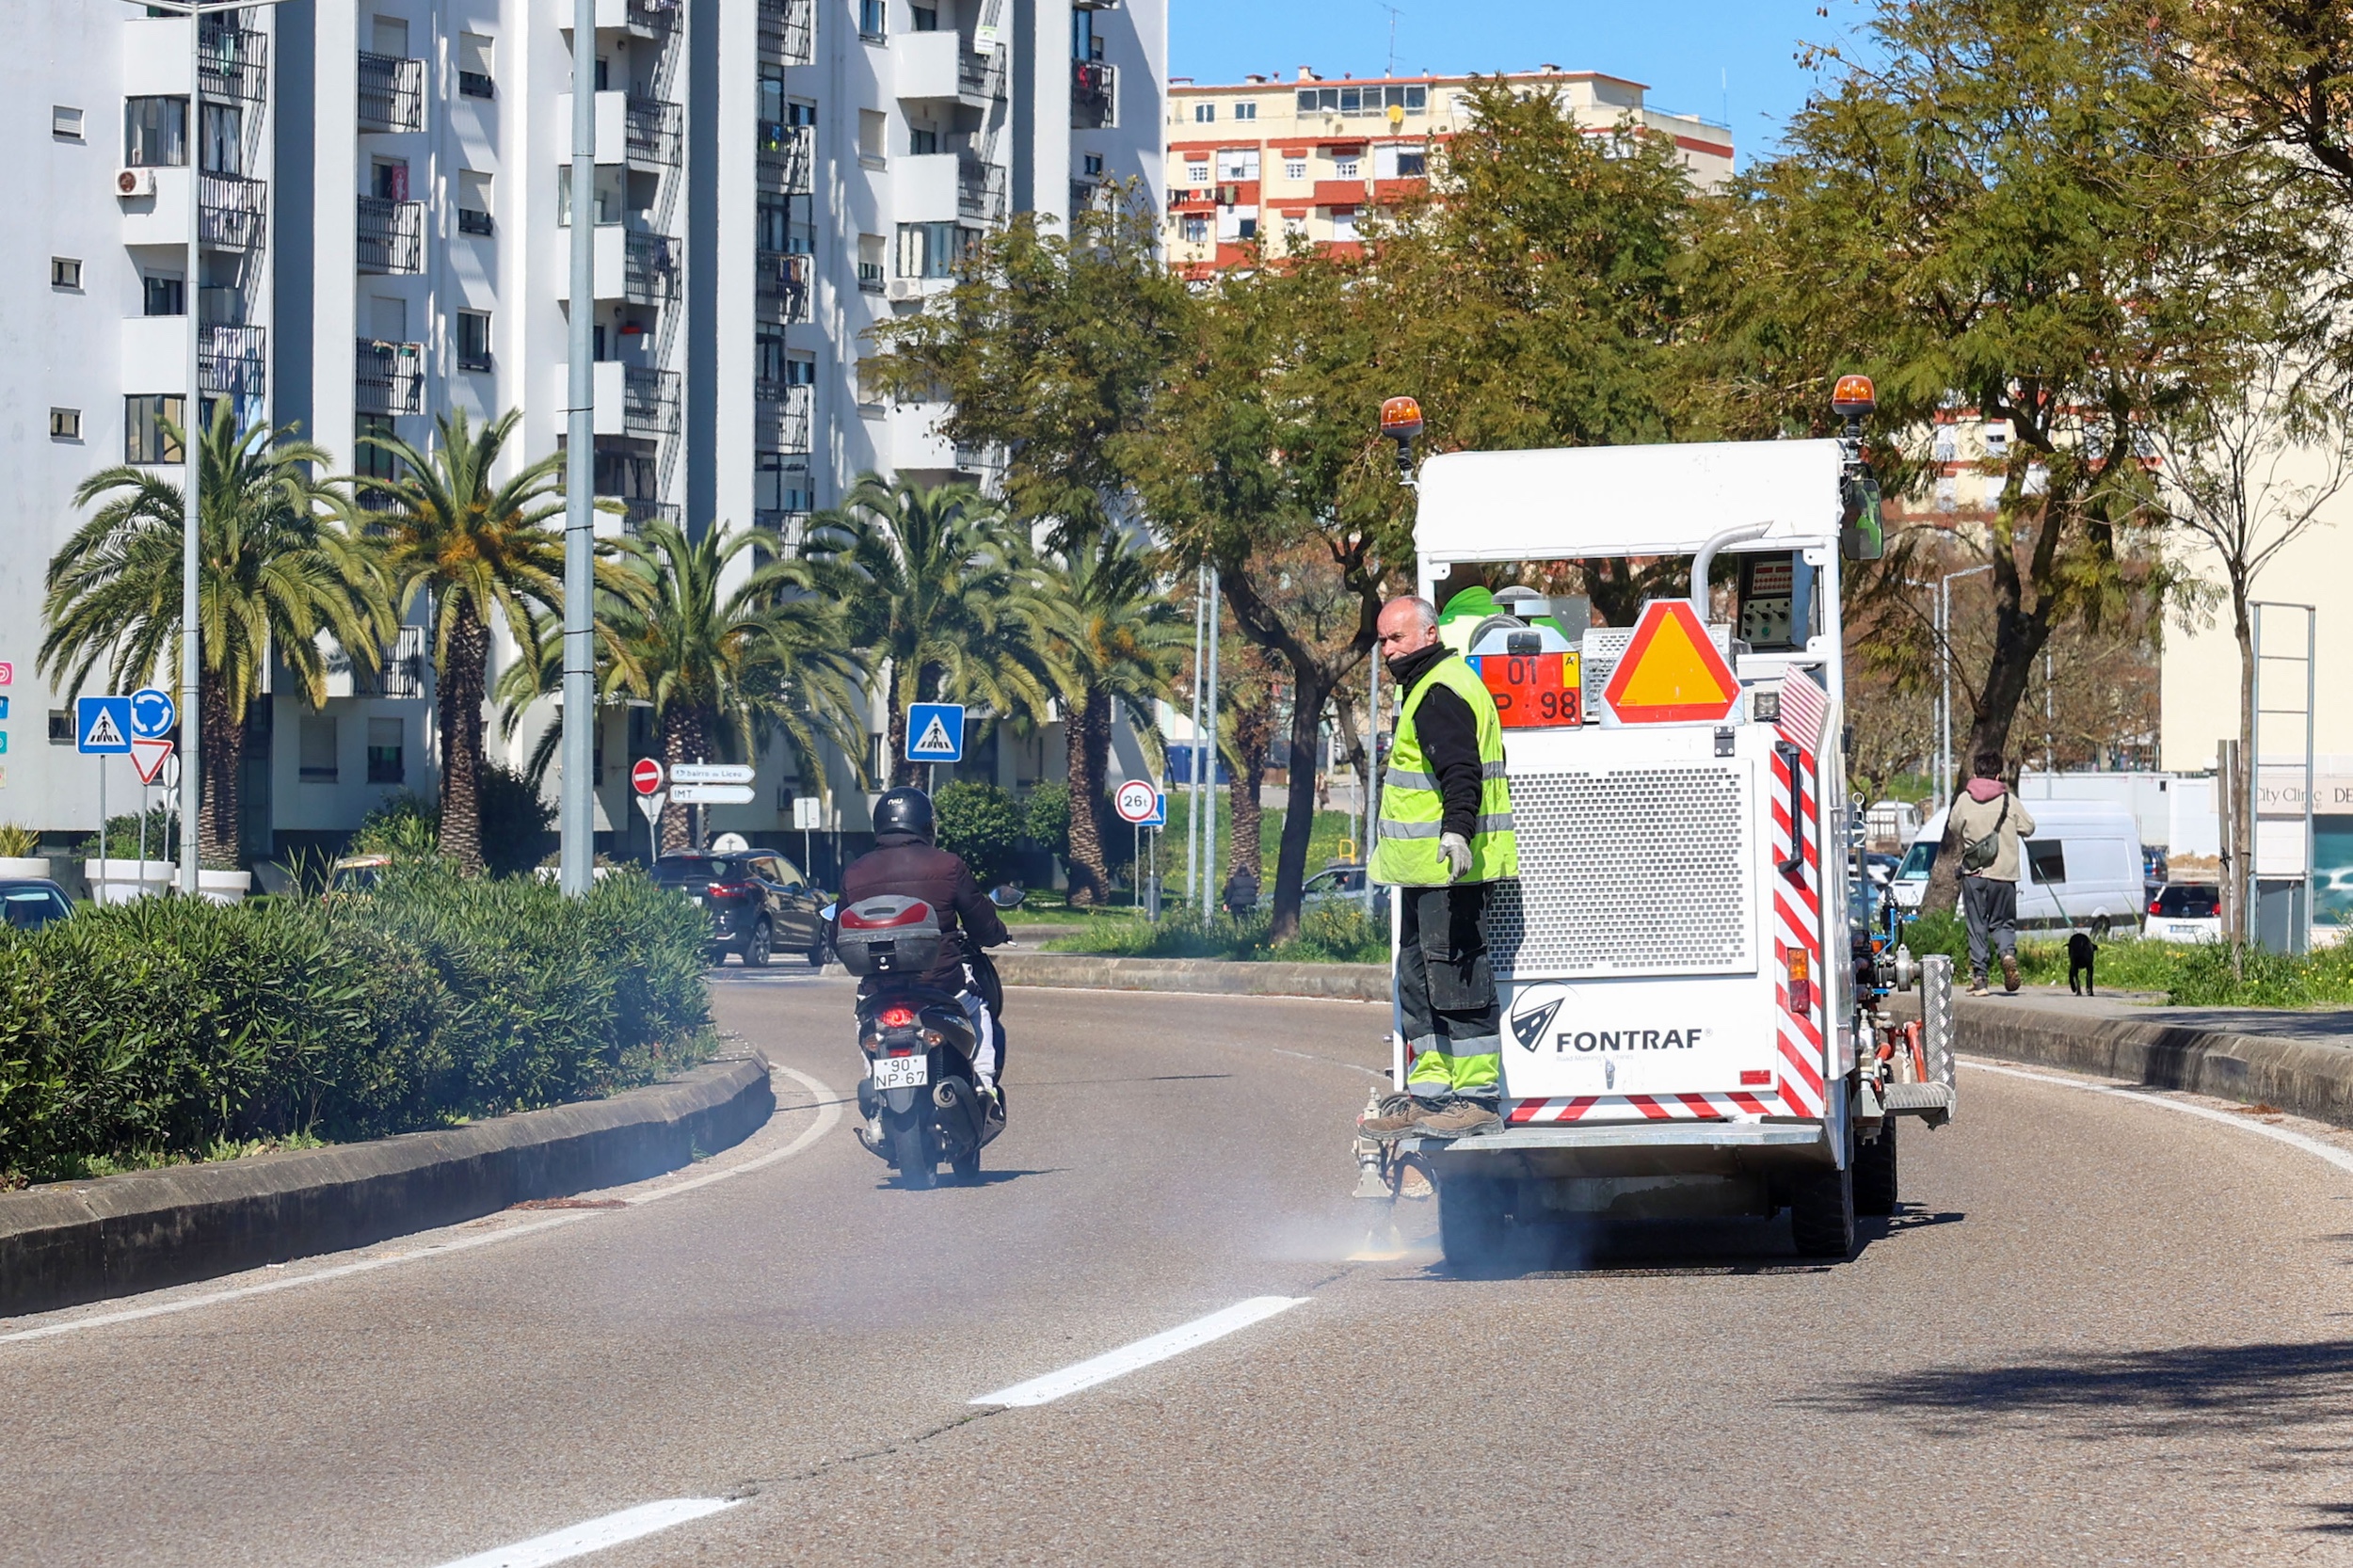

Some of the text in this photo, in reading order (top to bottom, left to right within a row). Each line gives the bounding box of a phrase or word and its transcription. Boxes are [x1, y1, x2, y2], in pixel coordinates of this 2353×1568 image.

[1508, 658, 1537, 685] 01
[1541, 691, 1577, 719] 98
[674, 789, 693, 798] IMT
[1556, 1029, 1702, 1052] FONTRAF
[891, 1059, 910, 1072] 90
